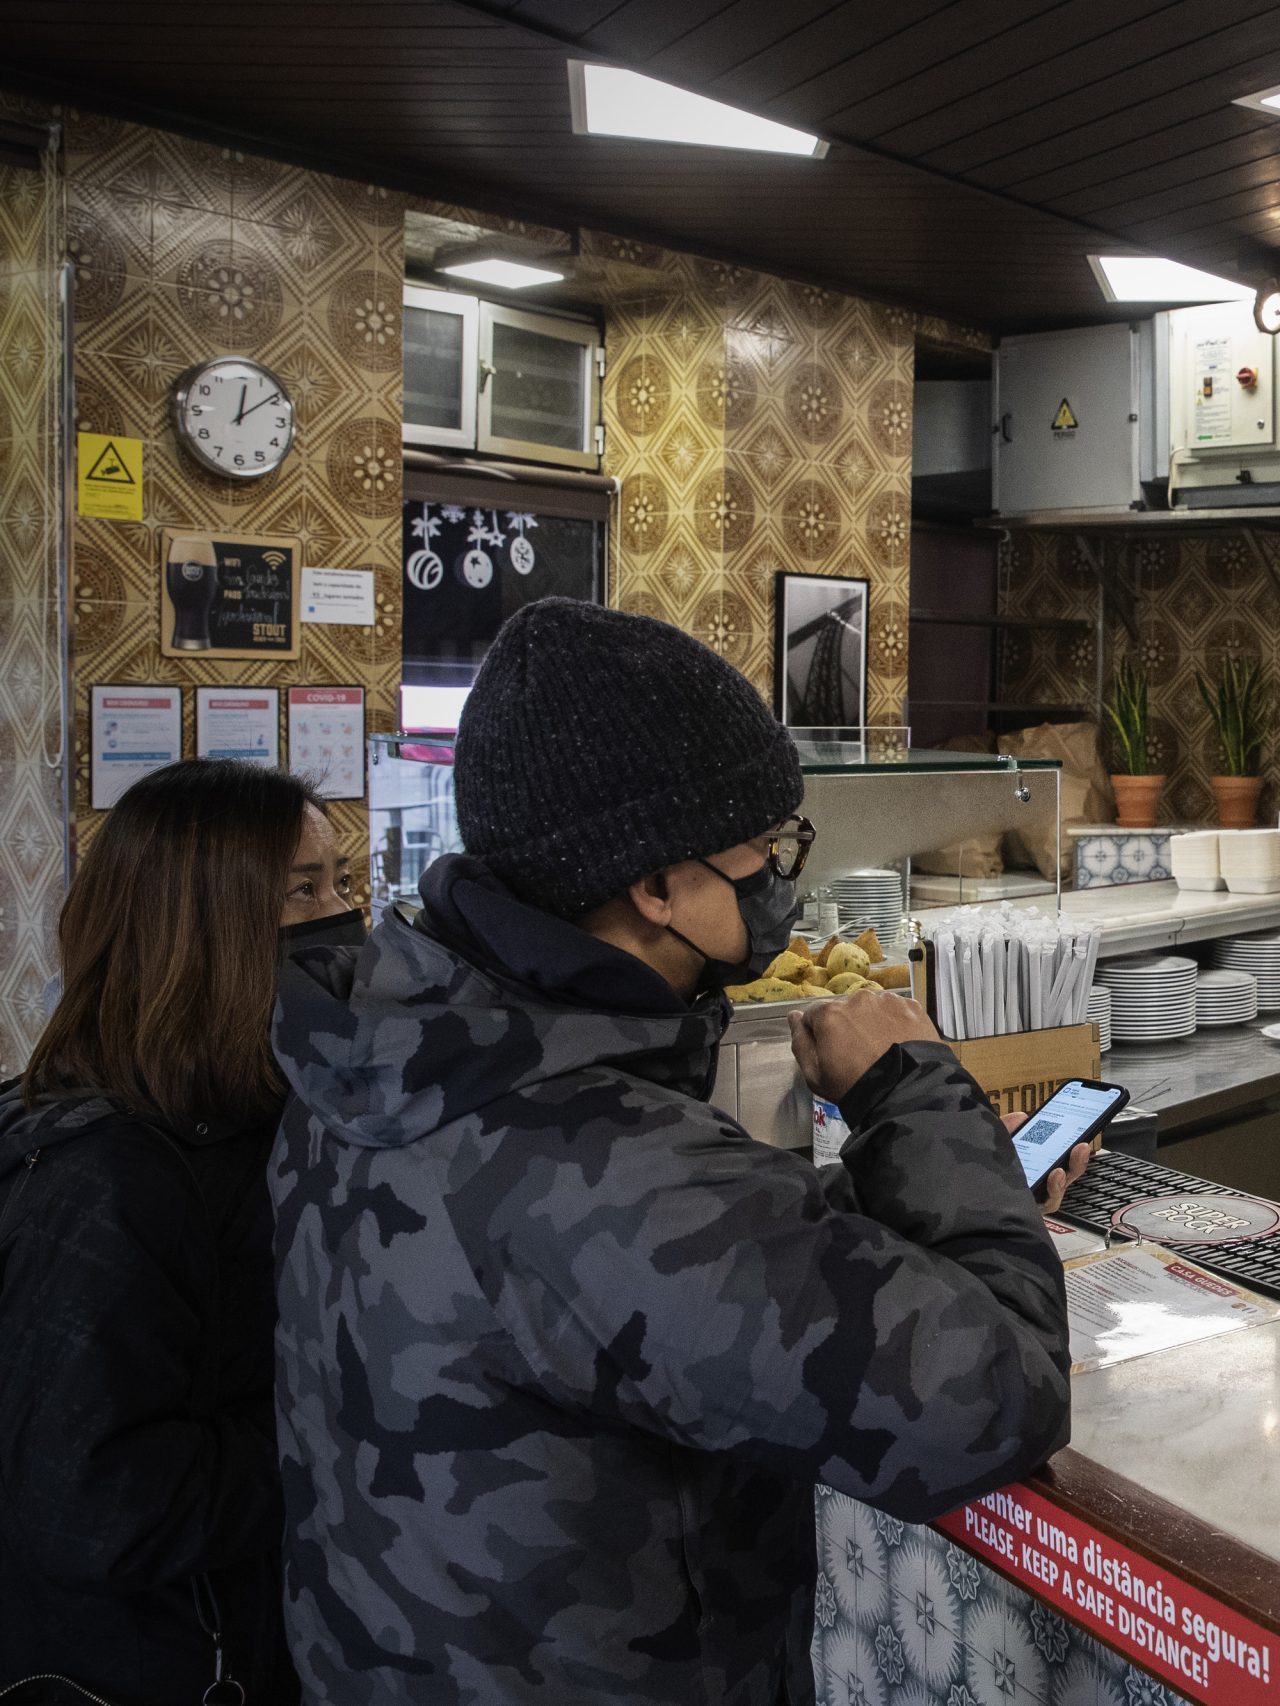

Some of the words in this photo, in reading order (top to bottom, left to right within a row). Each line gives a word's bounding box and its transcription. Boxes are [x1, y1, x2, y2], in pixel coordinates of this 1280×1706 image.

[253, 623, 286, 637] STOUT
[307, 693, 346, 702] COVID-19
[987, 1079, 1063, 1113] STOU
[1151, 1209, 1220, 1234] BOCK
[1171, 1202, 1251, 1230] SUPER
[1170, 1264, 1194, 1280] CASA
[1194, 1276, 1234, 1296] GUEDES
[965, 1506, 1019, 1568] PLEASE,
[1022, 1543, 1059, 1587] KEEP
[1062, 1571, 1074, 1600] A
[1076, 1579, 1114, 1627] SAFE
[1119, 1604, 1209, 1688] DISTANCE!
[1037, 1516, 1078, 1565] uma
[1083, 1539, 1176, 1625] distância
[1182, 1606, 1271, 1685] segura!
